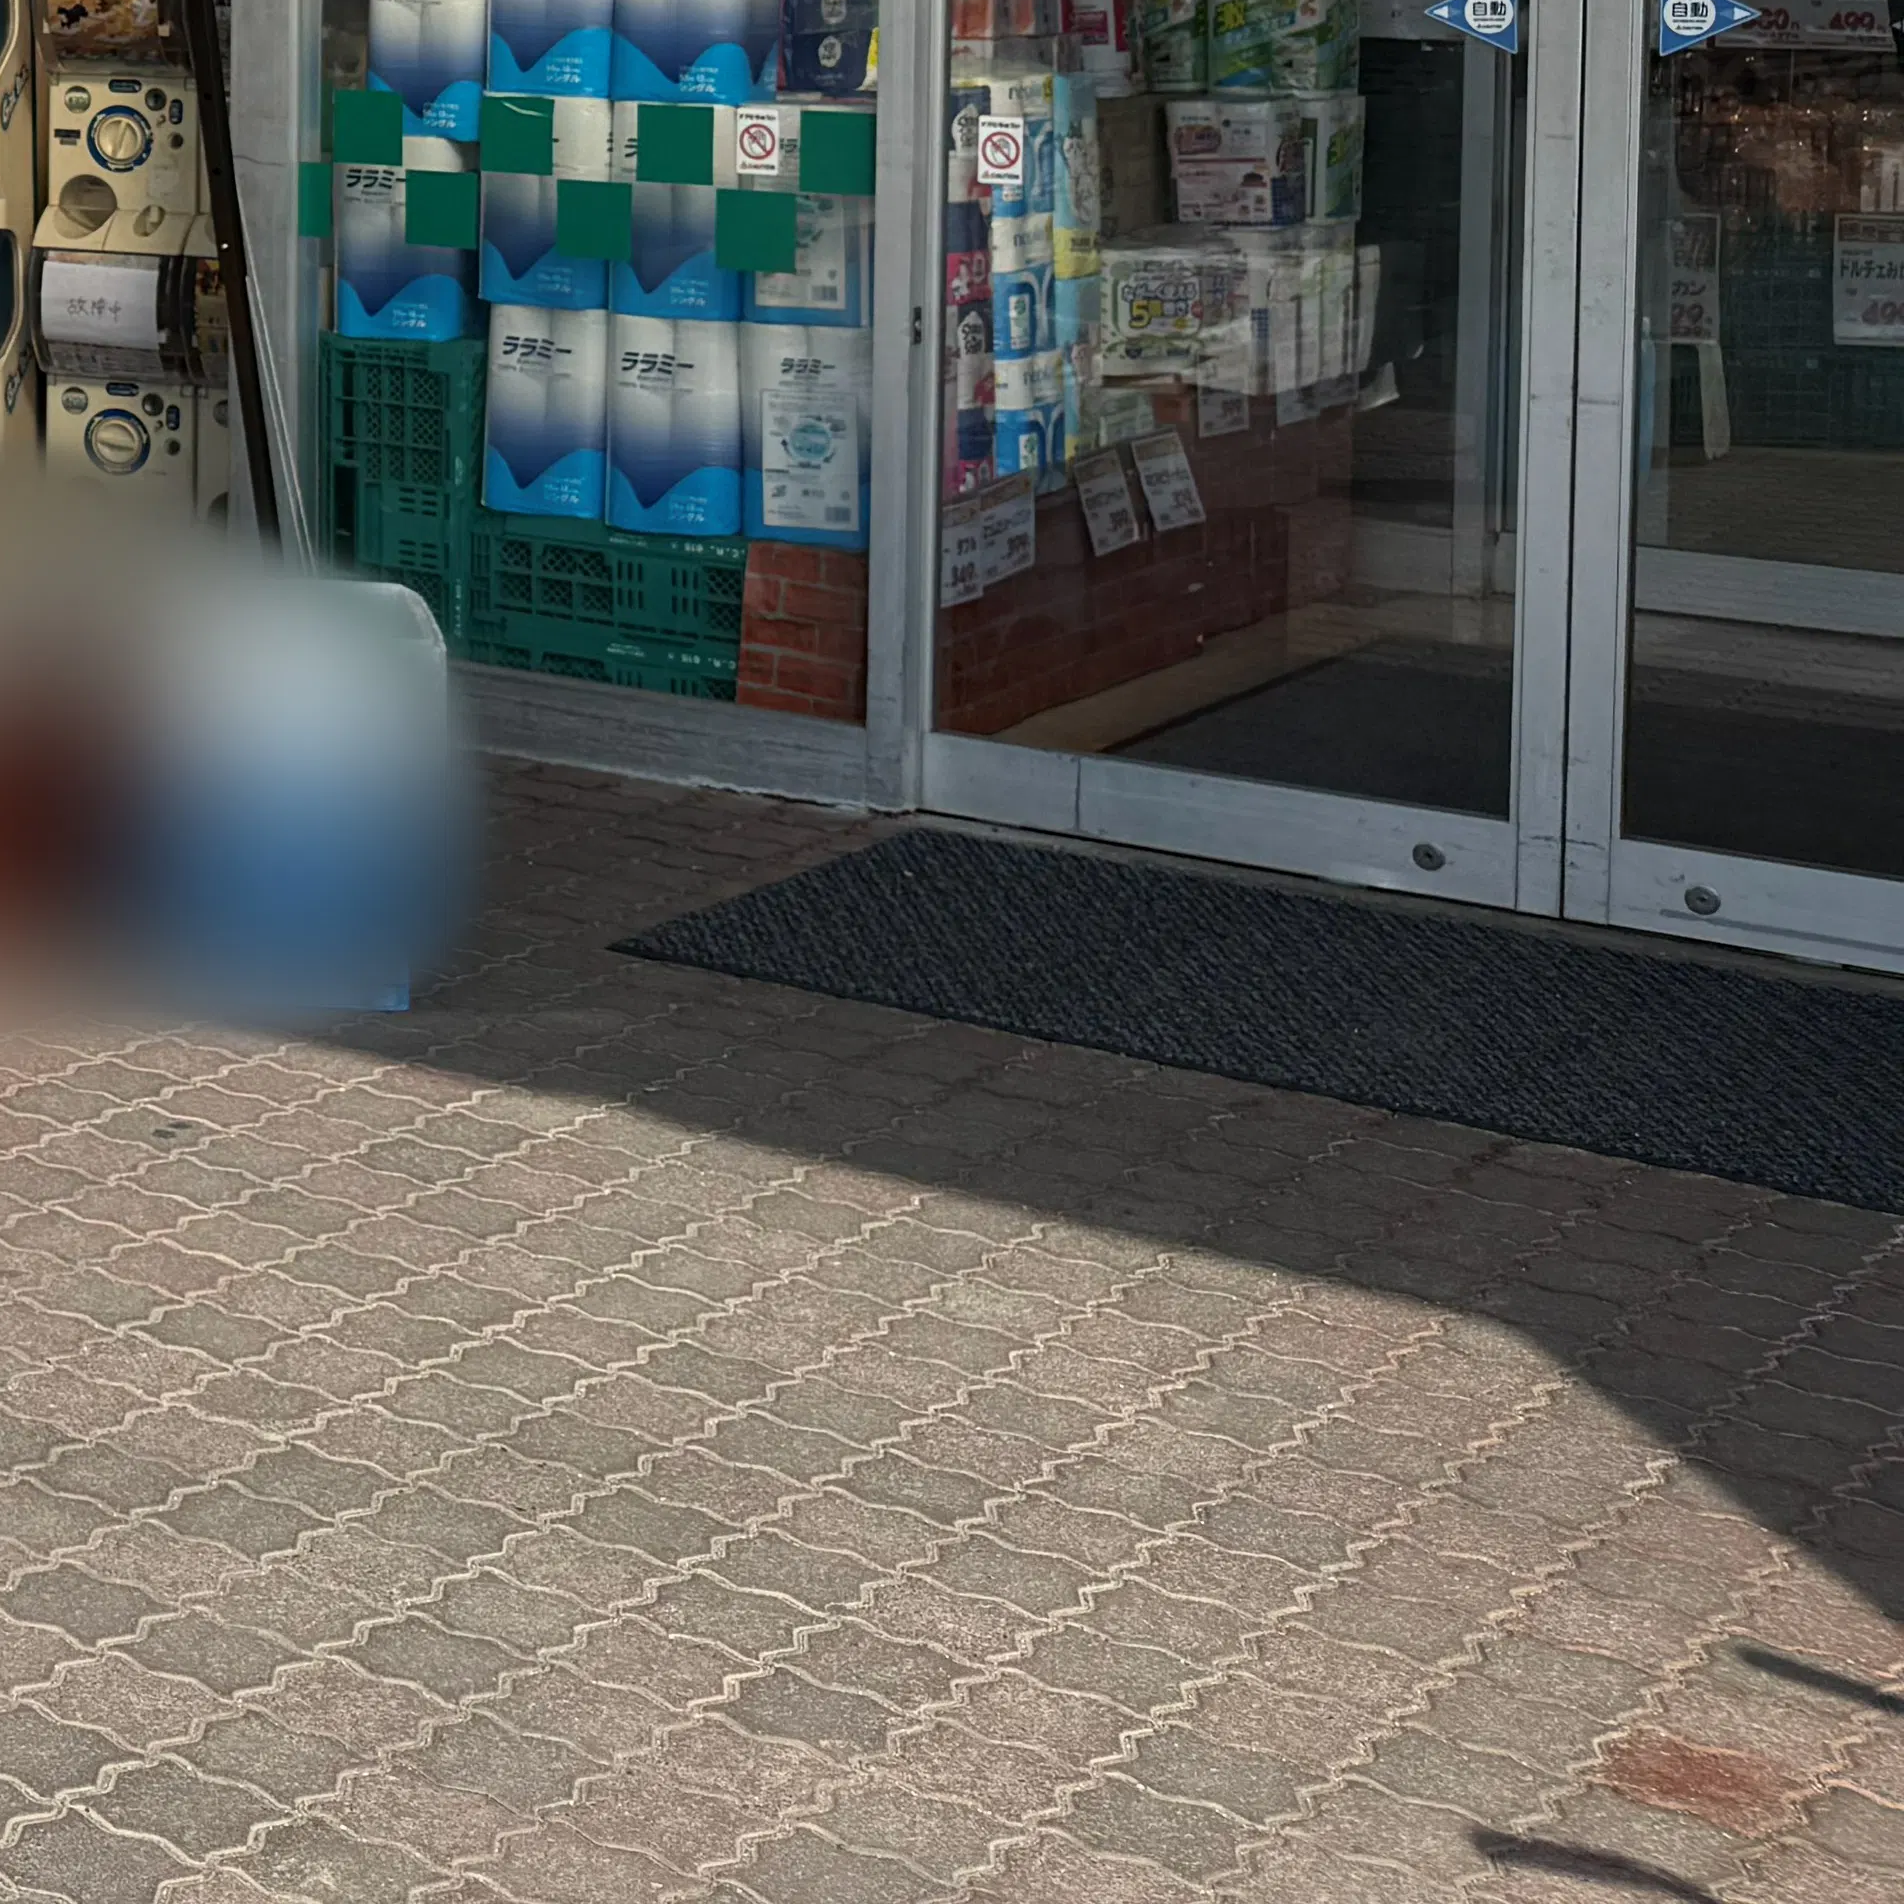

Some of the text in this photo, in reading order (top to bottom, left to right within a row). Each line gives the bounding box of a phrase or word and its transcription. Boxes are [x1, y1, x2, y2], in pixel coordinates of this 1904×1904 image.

[1472, 0, 1507, 16] 自動
[1671, 1, 1709, 18] 自動
[503, 335, 572, 360] ララミー
[621, 351, 694, 375] ララミー
